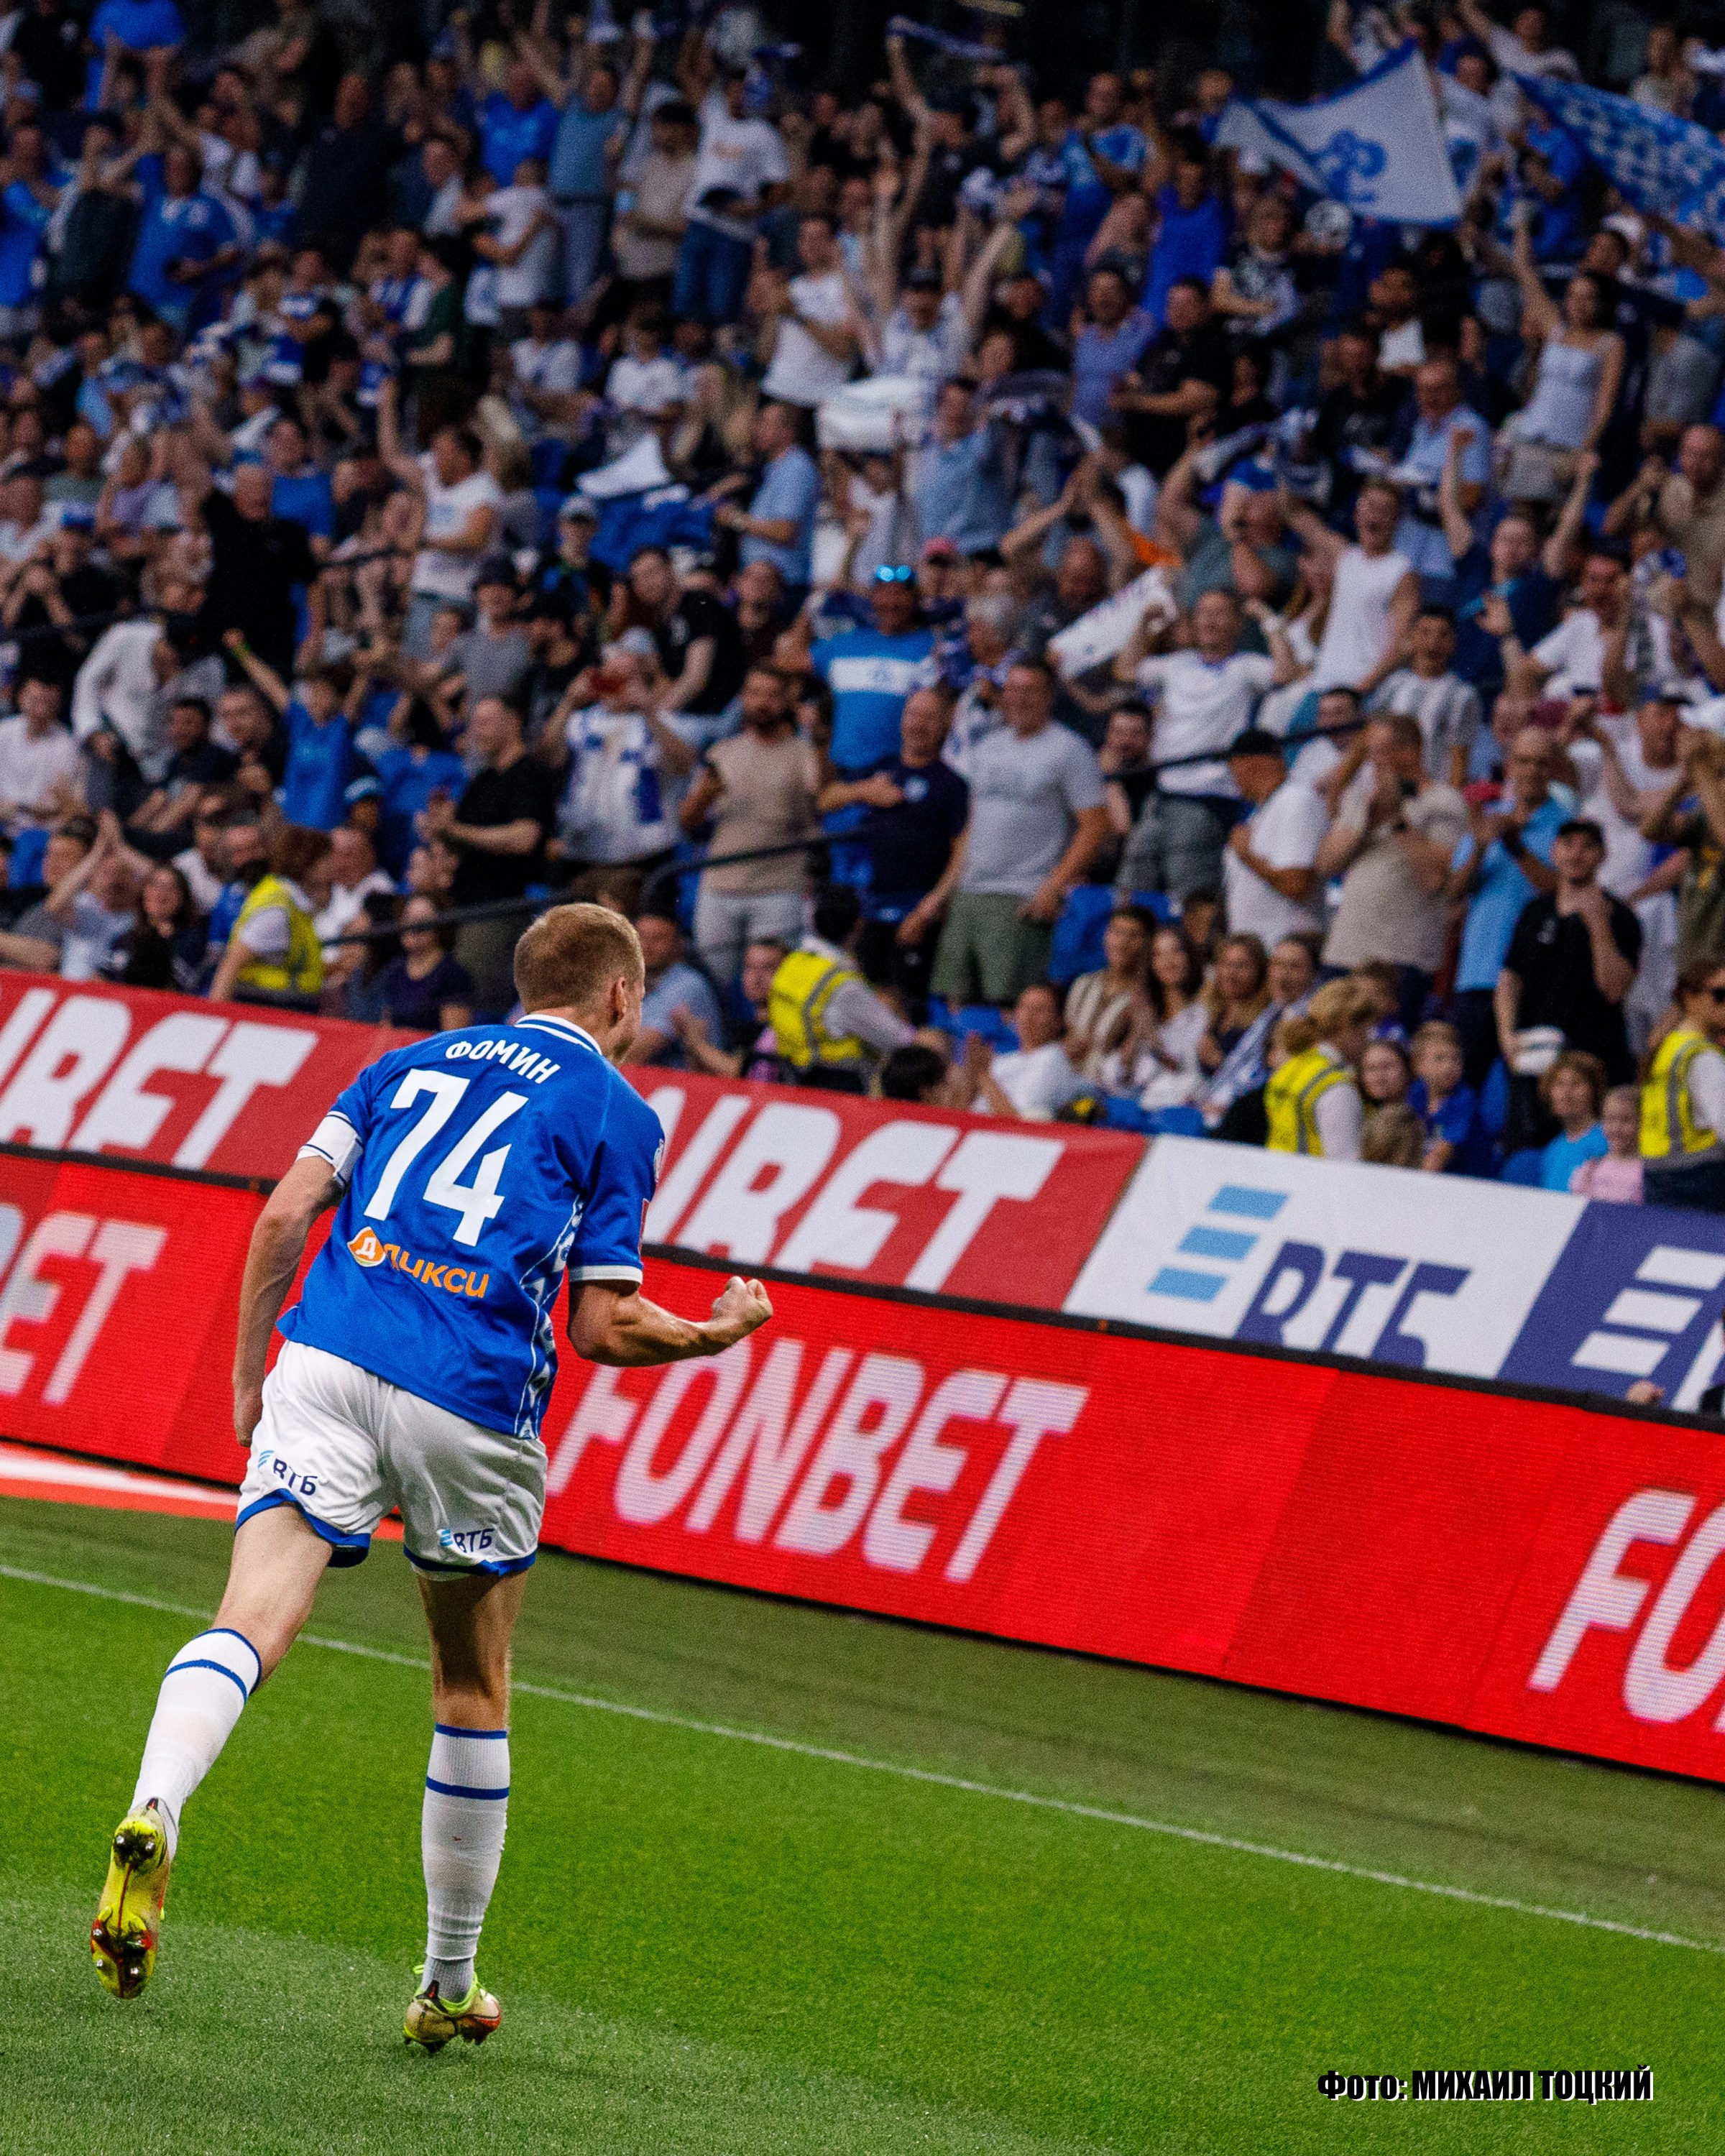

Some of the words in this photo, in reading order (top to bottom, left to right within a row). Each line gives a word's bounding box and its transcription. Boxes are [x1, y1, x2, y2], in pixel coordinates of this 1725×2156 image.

[446, 1039, 561, 1084] ФОМИН
[364, 1068, 529, 1247] 74
[0, 1203, 167, 1406] ET
[546, 1335, 1090, 1583] FONBET
